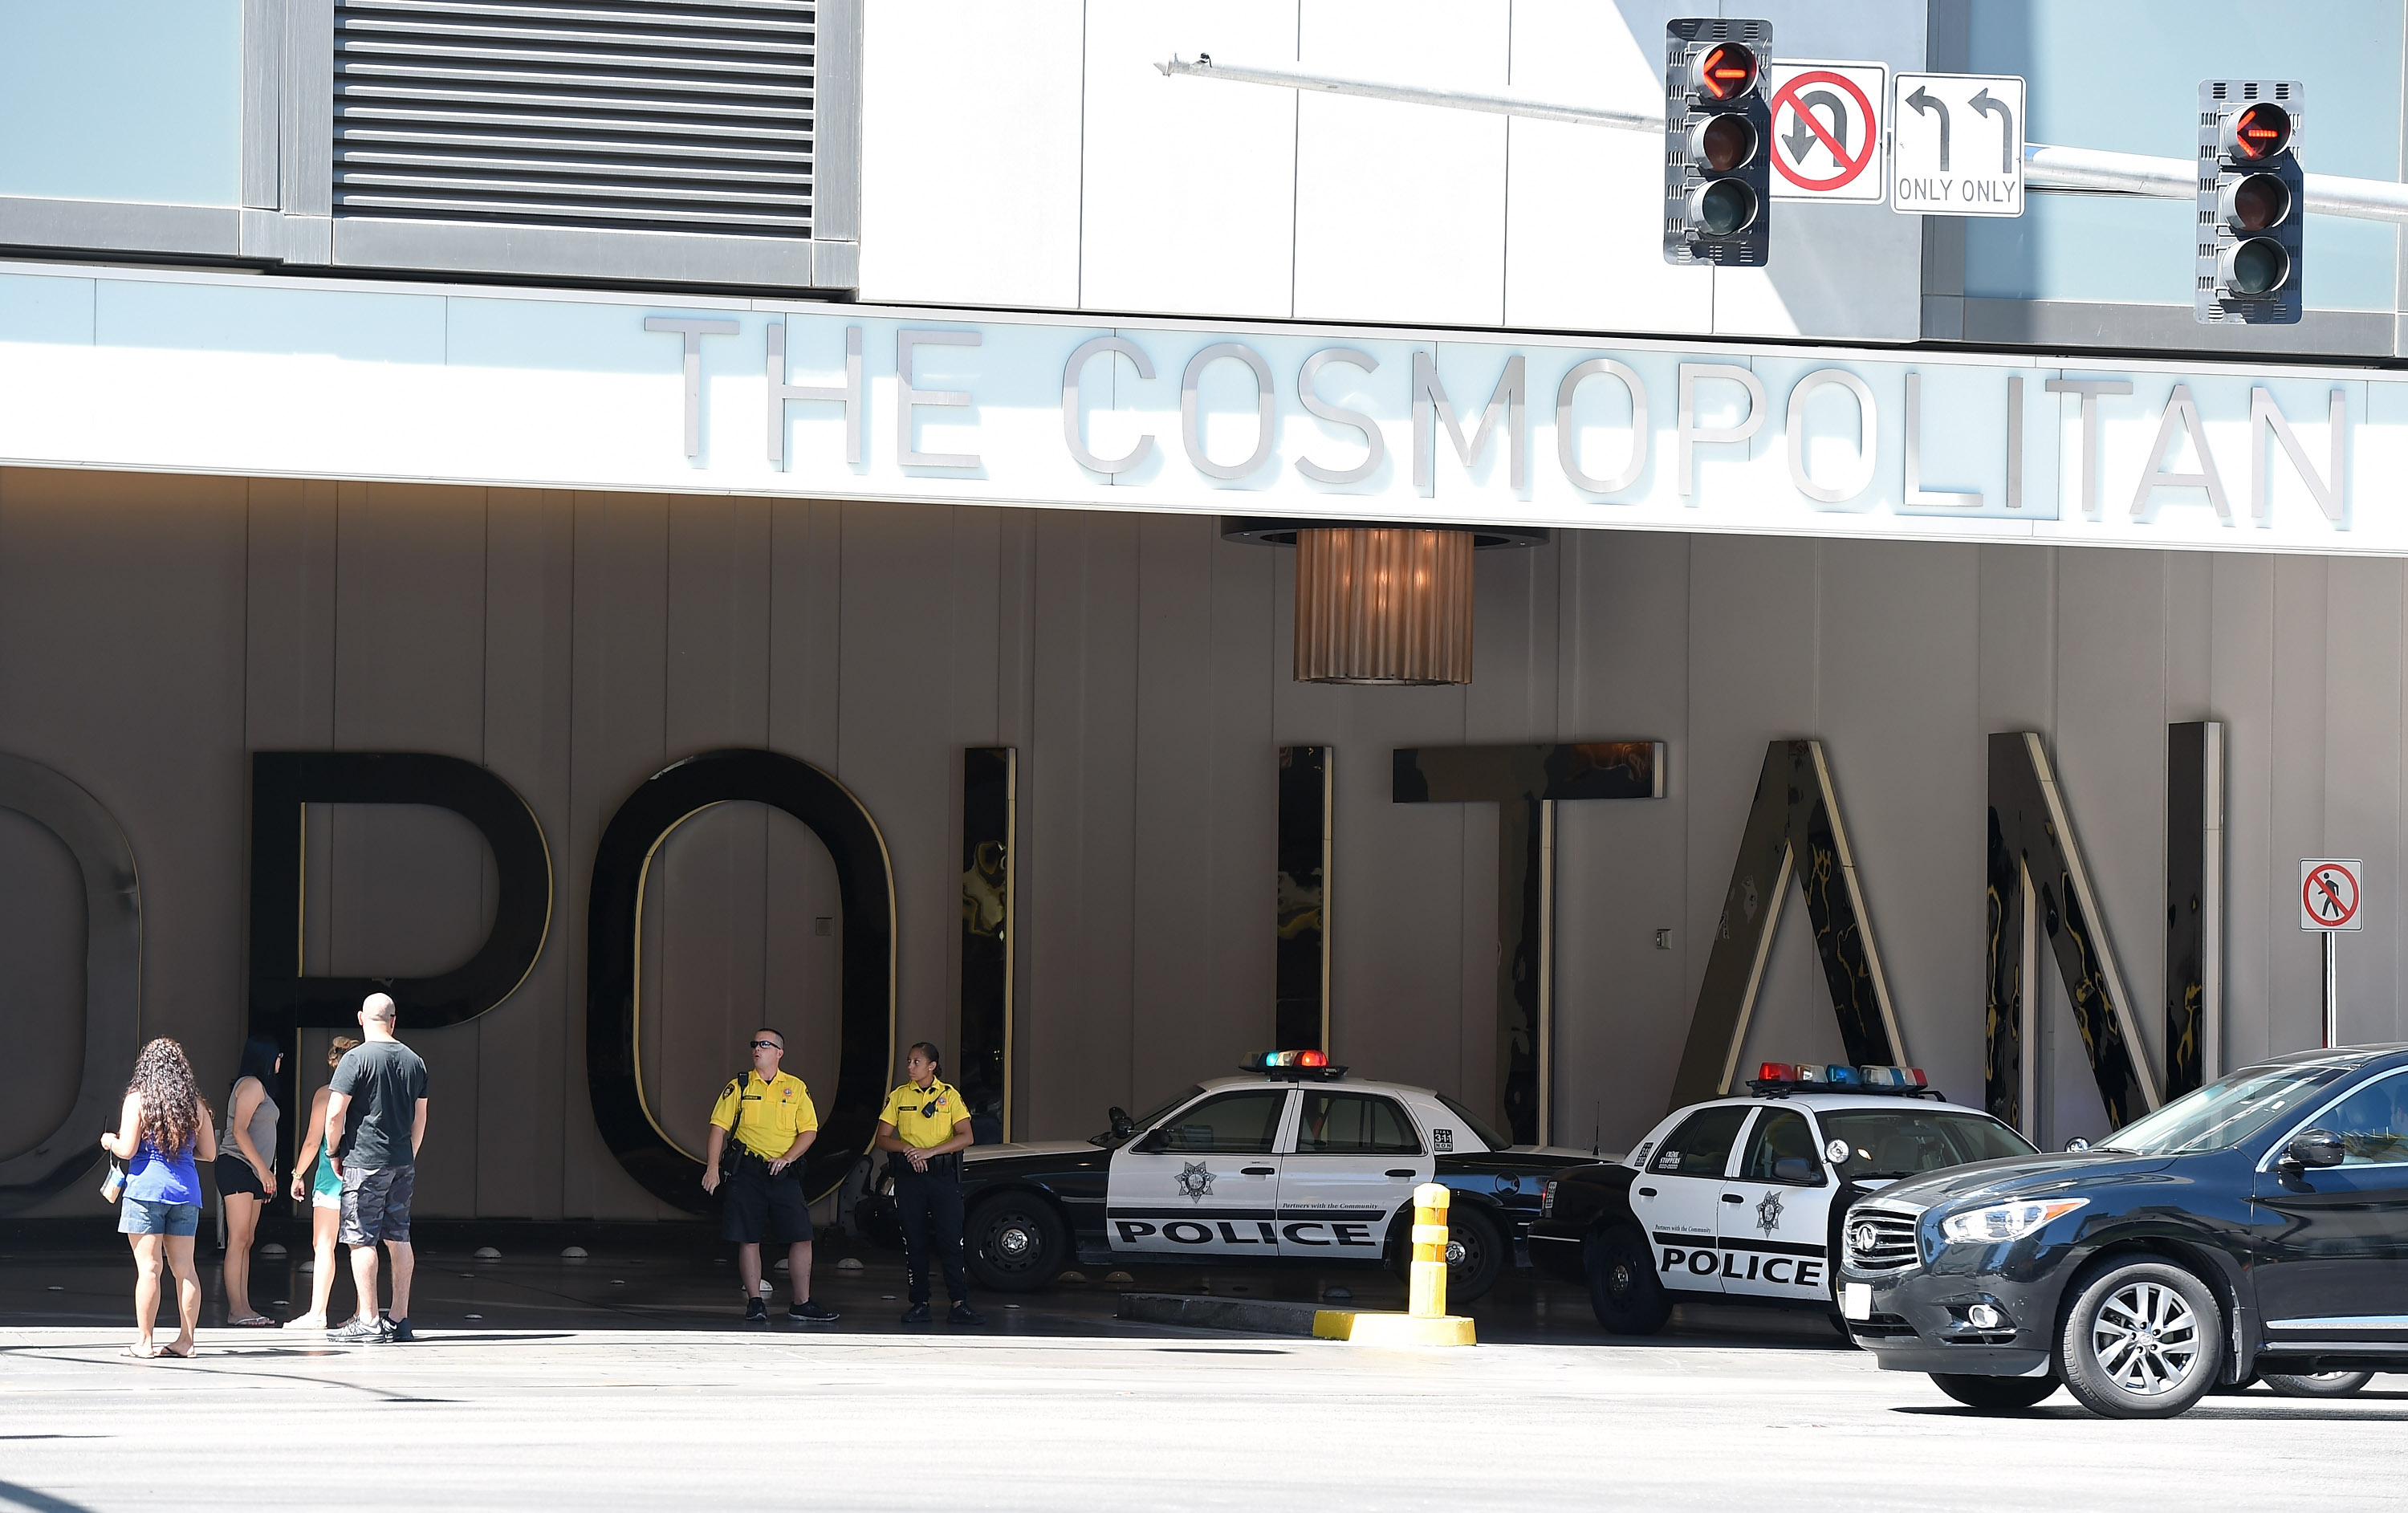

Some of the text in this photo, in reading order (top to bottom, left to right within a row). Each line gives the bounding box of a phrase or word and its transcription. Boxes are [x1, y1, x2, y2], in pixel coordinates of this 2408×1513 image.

[1899, 178, 2016, 202] ONLY ONLY
[644, 316, 2346, 521] THE COSMOPOLITAN
[1340, 1202, 1379, 1210] Community
[1114, 1221, 1377, 1247] POLICE
[1688, 1226, 1711, 1234] Community
[1661, 1247, 1824, 1287] POLICE
